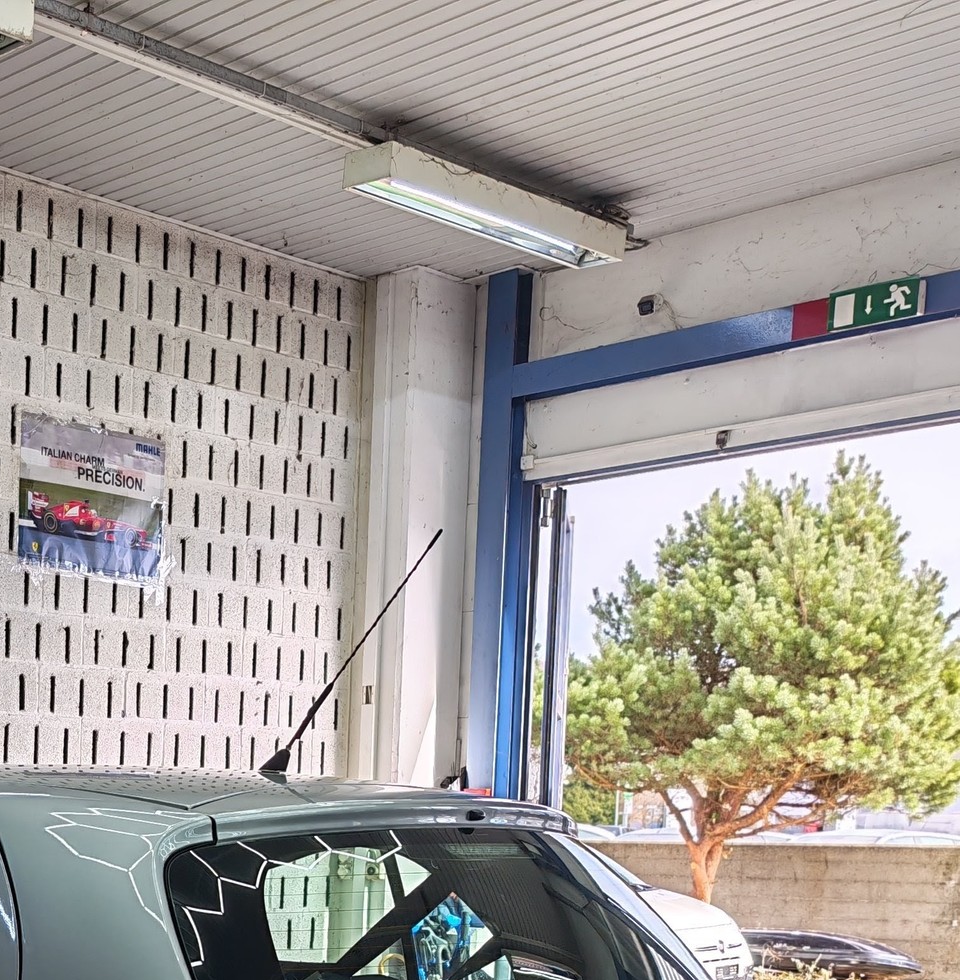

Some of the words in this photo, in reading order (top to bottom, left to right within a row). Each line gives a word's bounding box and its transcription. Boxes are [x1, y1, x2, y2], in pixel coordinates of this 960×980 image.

[40, 446, 73, 461] ITALIAN
[74, 453, 105, 467] CHARM
[135, 442, 161, 457] MAHLE
[77, 466, 145, 493] PRECISION.
